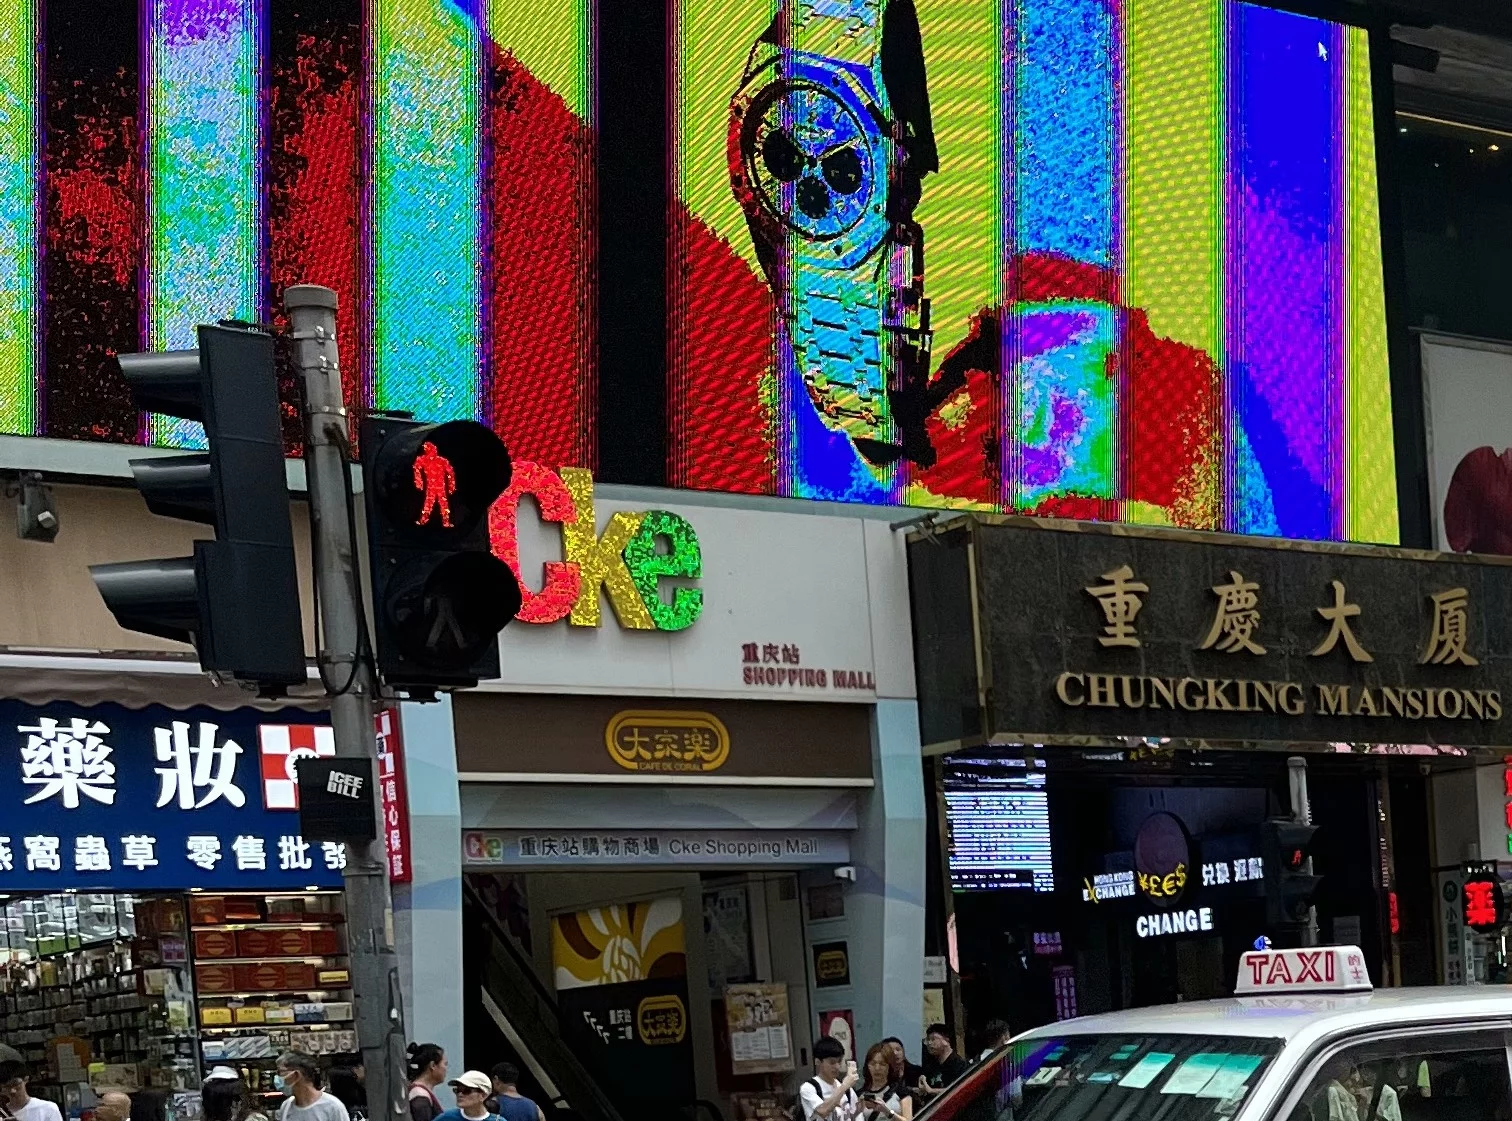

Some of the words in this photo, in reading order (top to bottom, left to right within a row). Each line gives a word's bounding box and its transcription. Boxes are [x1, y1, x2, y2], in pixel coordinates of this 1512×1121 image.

[489, 460, 703, 631] Cke
[741, 642, 801, 665] 重庆站
[742, 666, 828, 689] SHOPPING
[832, 669, 876, 691] MALL
[1056, 672, 1306, 715] CHUNGKING
[1318, 683, 1503, 721] MANSIONS
[17, 716, 247, 811] 藥妝
[520, 835, 661, 858] 重庆站購物商場
[669, 838, 701, 856] Cke
[705, 838, 782, 862] Shopping
[786, 839, 818, 856] Mall
[1136, 907, 1214, 938] CHANGE
[1246, 951, 1336, 985] TAXI
